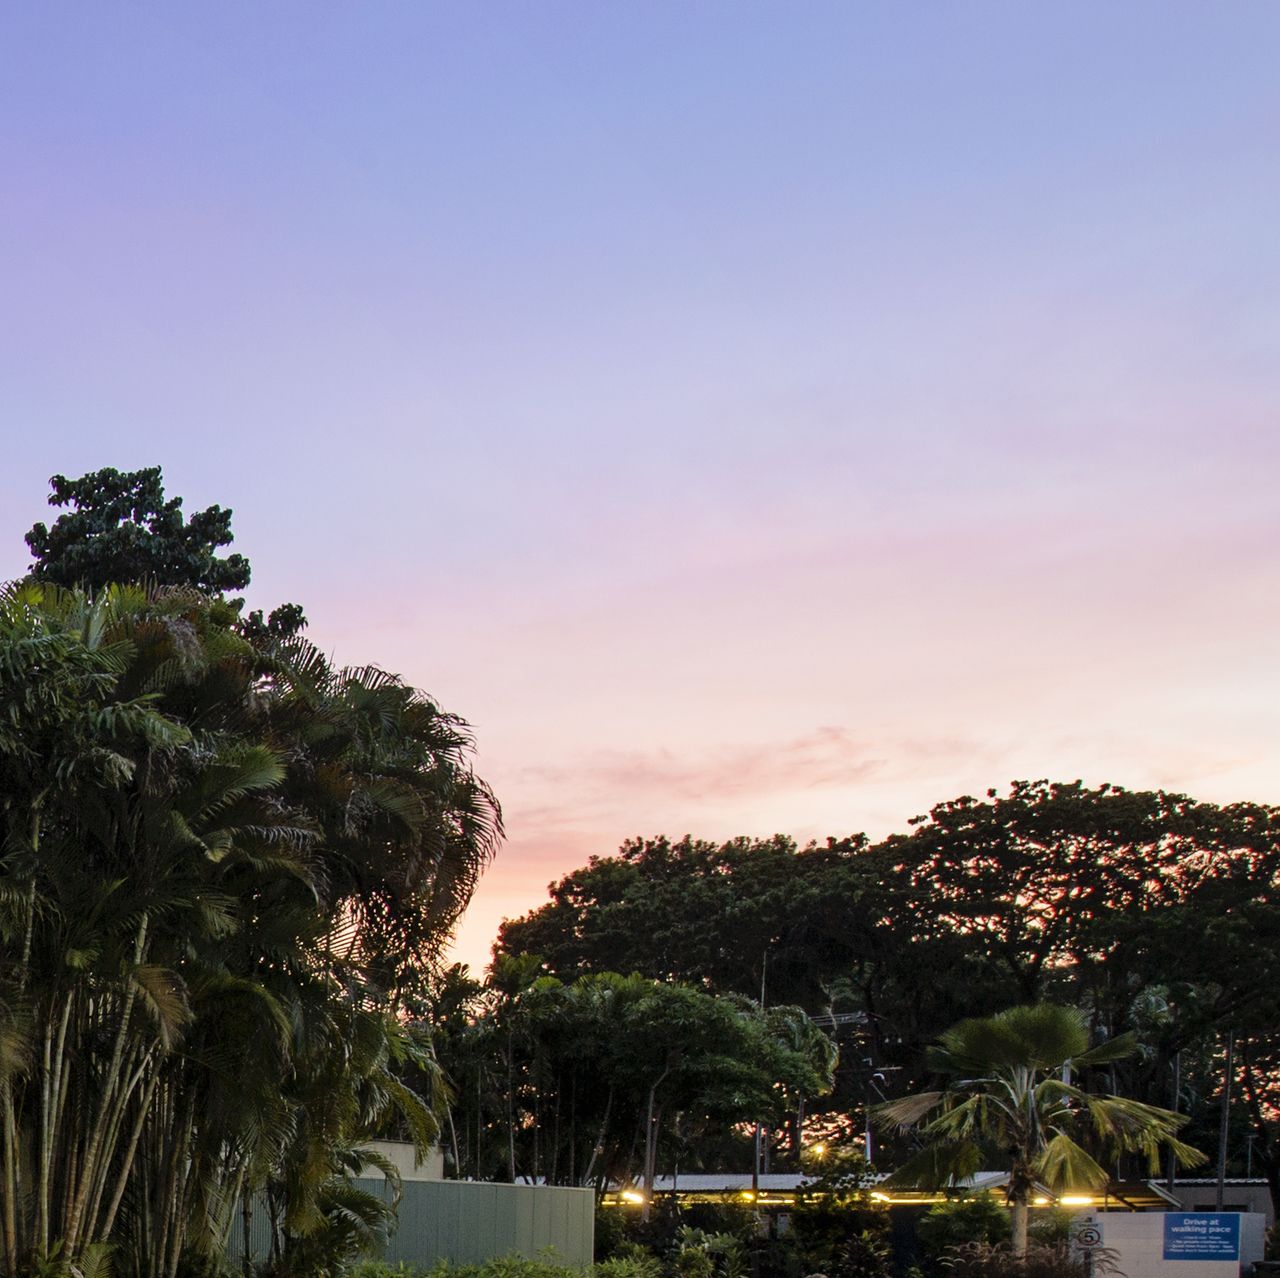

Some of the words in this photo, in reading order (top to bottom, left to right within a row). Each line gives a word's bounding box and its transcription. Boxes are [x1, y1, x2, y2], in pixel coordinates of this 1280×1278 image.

[1184, 1218, 1208, 1226] Drive
[1171, 1226, 1207, 1234] walking
[1084, 1231, 1094, 1242] 5
